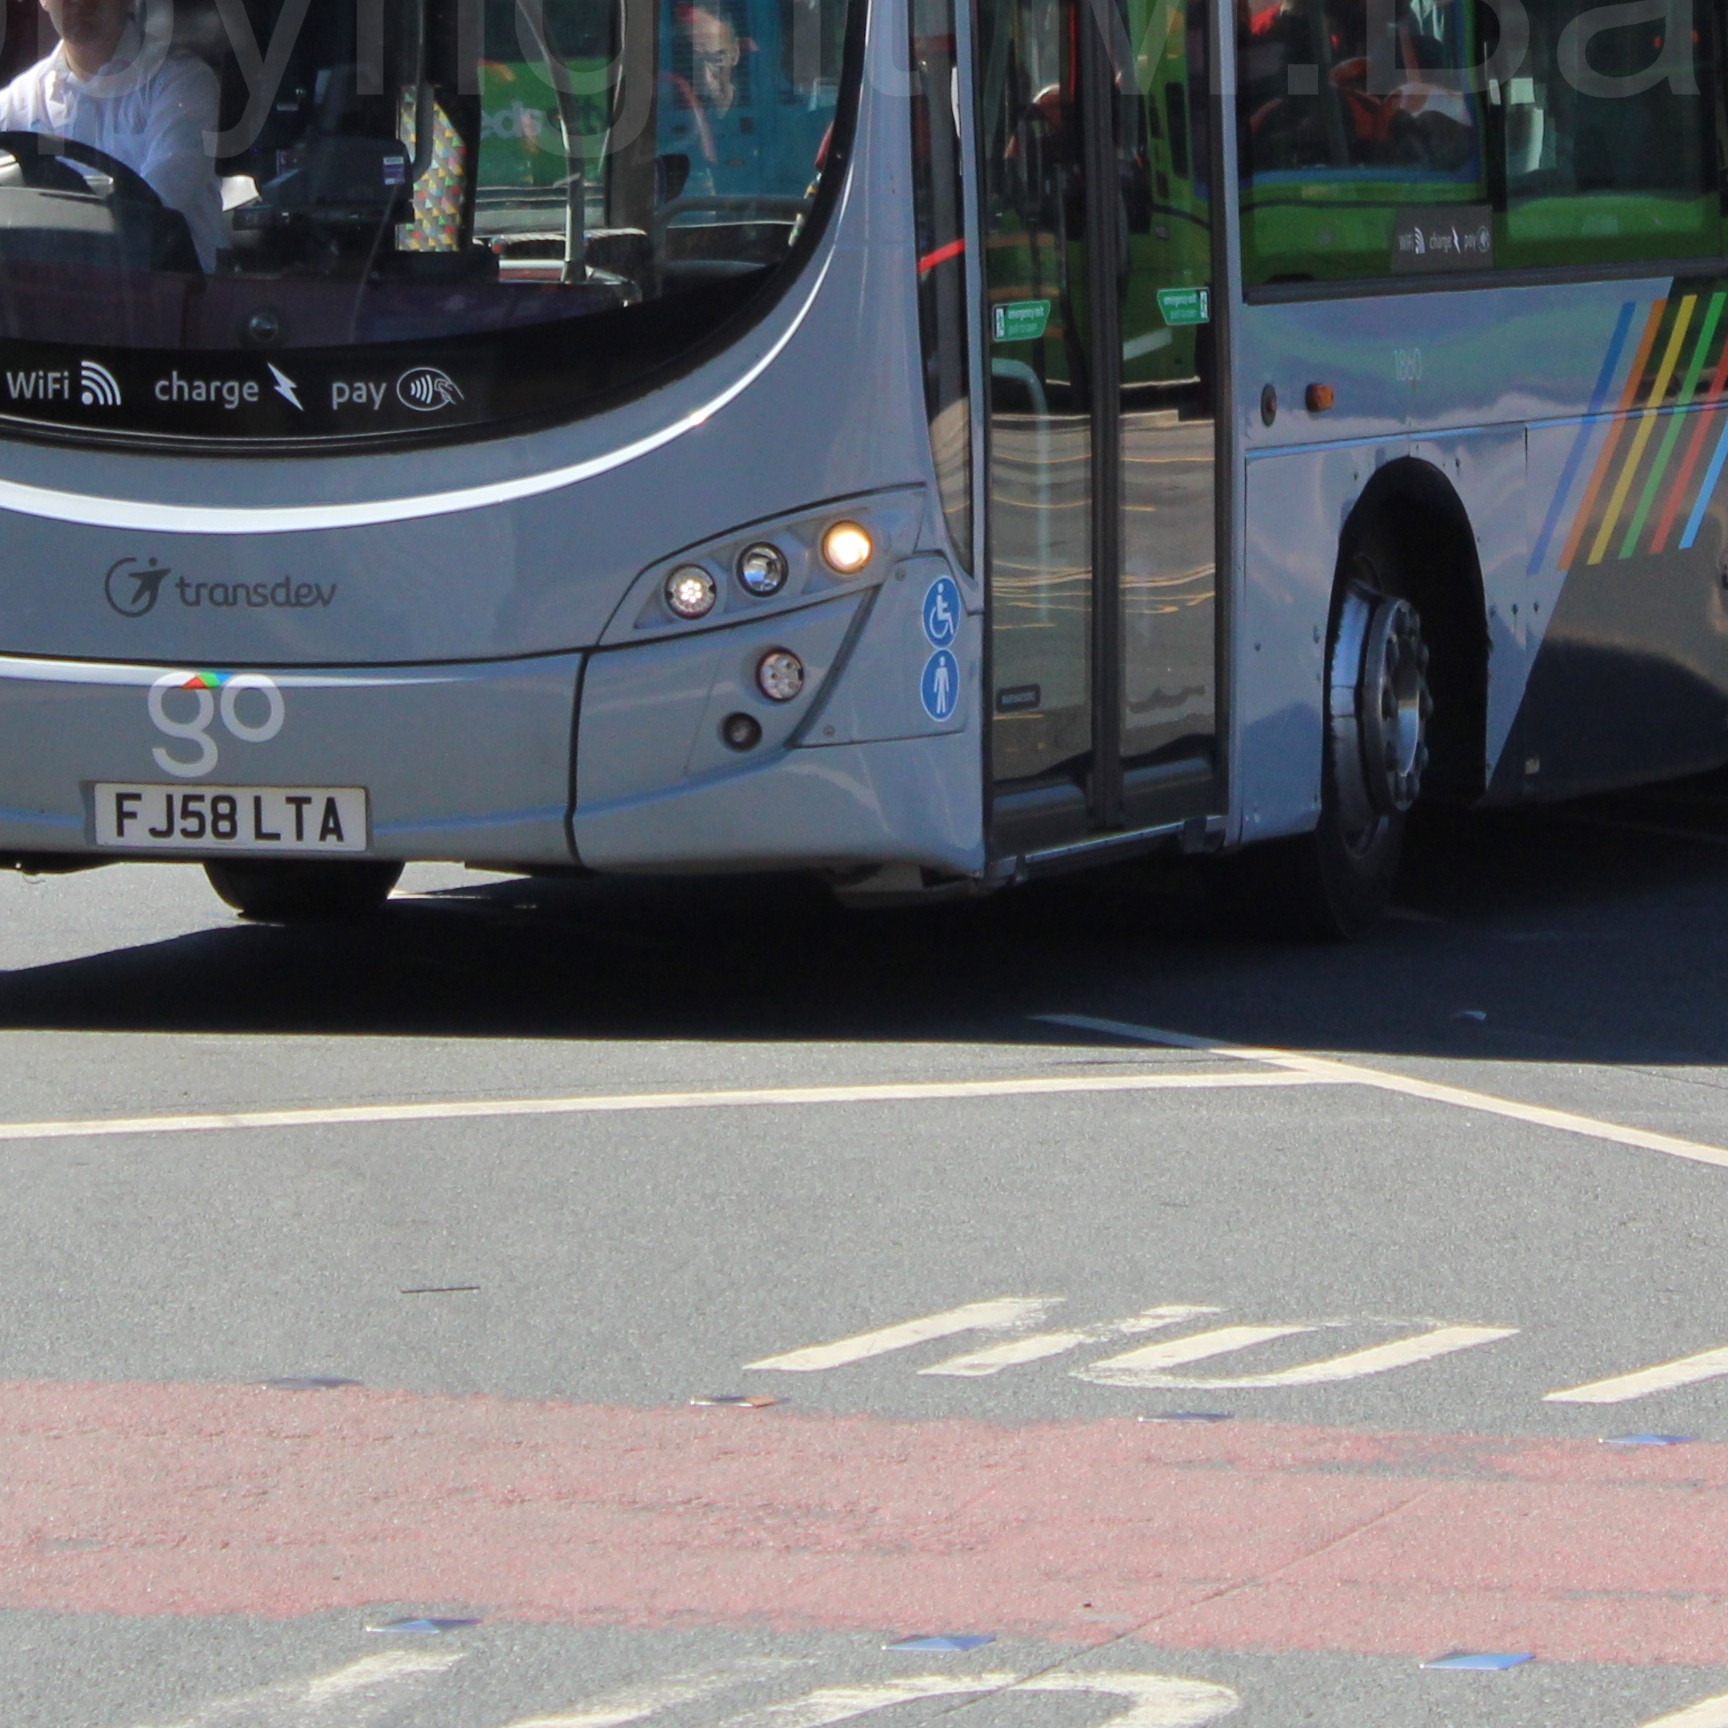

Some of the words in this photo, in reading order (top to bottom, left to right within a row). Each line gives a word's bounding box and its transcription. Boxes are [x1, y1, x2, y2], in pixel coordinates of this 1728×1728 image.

[6, 371, 71, 401] WiFi
[154, 371, 259, 411] charge
[331, 378, 387, 411] pay
[175, 575, 338, 608] transdev
[147, 671, 286, 778] go
[114, 792, 238, 839] FJ58
[253, 795, 345, 843] LTA
